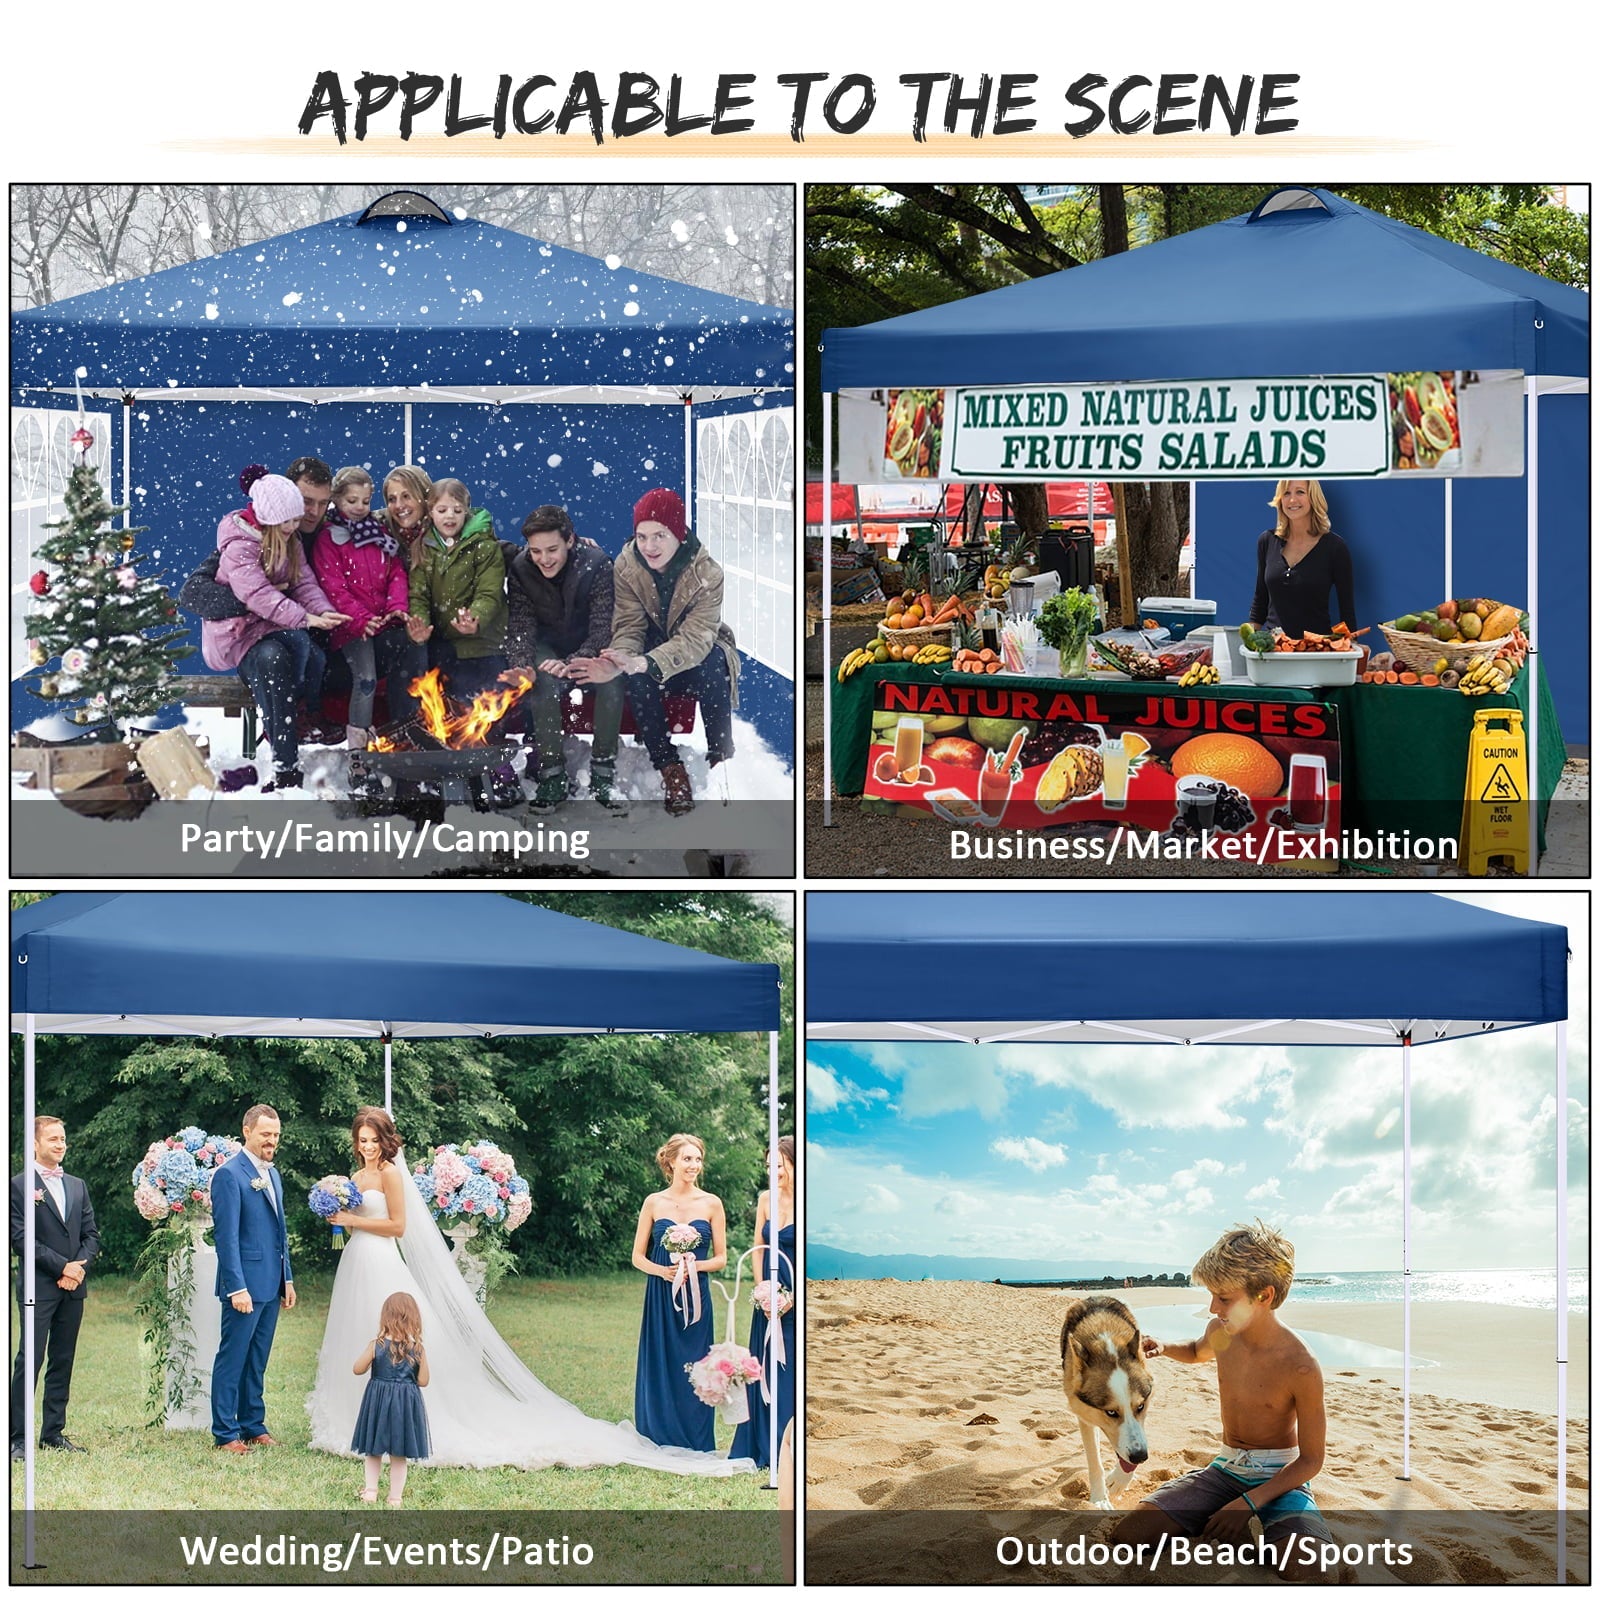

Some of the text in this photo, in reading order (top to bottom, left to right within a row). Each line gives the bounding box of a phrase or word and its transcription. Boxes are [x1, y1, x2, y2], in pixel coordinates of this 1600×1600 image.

[962, 384, 1378, 429] MIXED NATURAL JUICES
[1000, 429, 1326, 470] FRUITS SALADS
[884, 684, 1327, 738] NATURAL JUICES
[1483, 748, 1518, 759] CAUTION
[1490, 815, 1512, 823] FLOOR
[1494, 806, 1508, 814] WET
